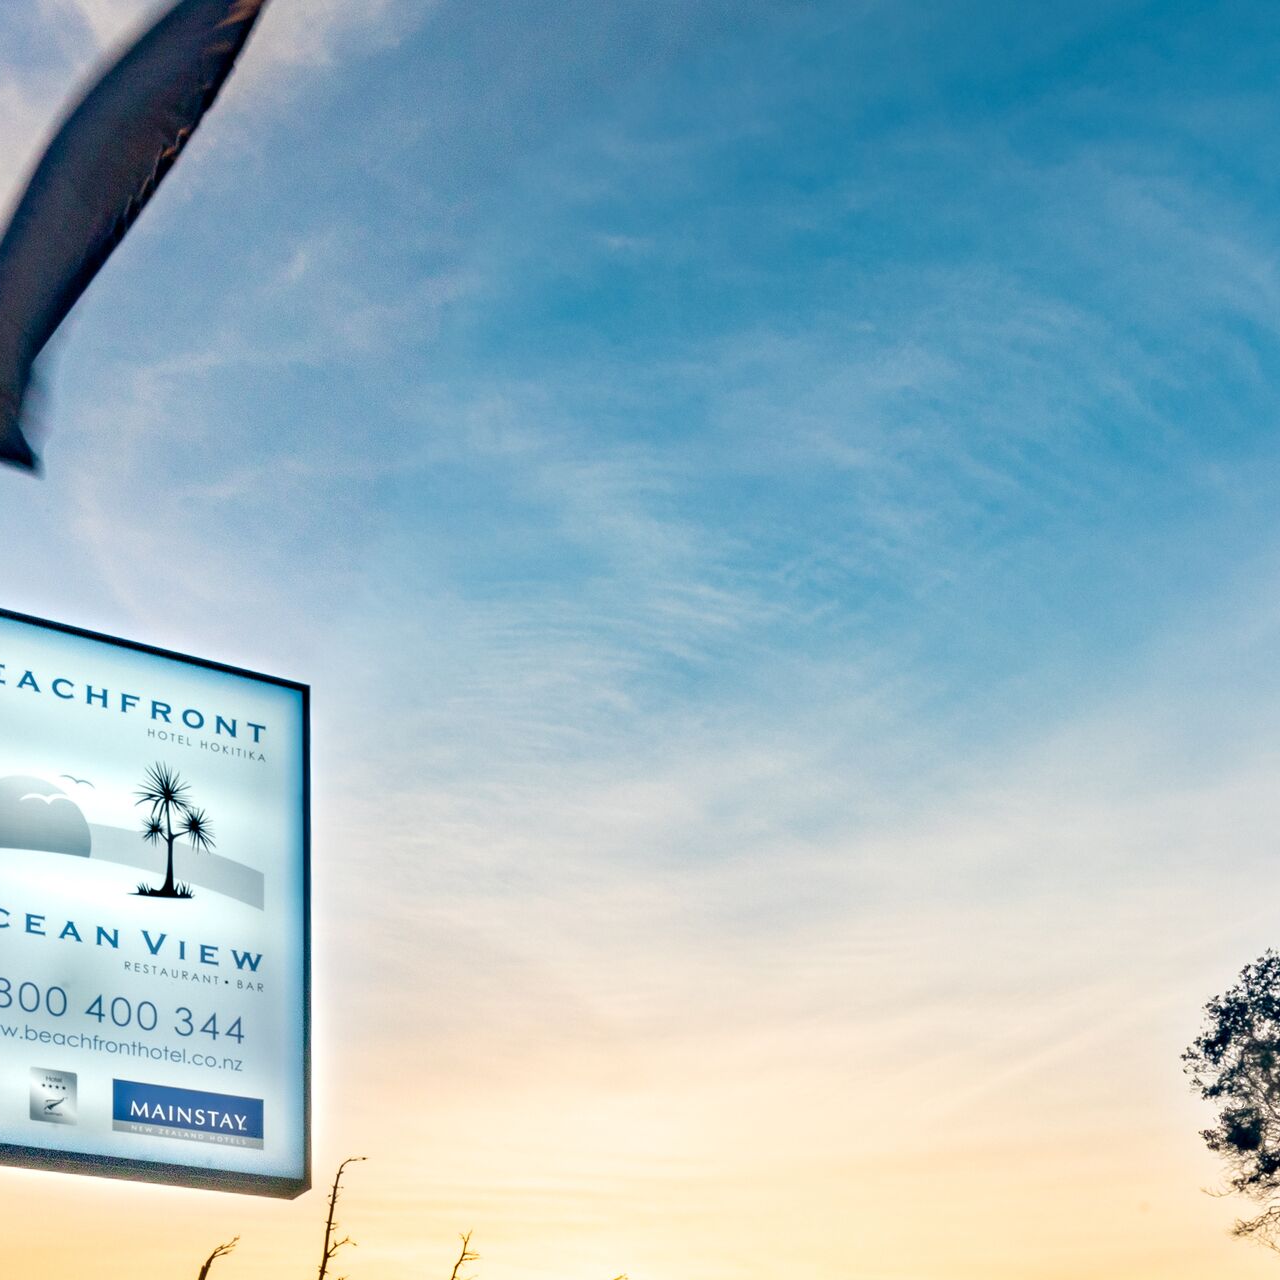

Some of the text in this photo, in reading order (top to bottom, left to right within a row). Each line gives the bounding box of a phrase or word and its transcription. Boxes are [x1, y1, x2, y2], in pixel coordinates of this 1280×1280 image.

[147, 728, 266, 762] HOTEL HOKITIKA
[141, 929, 263, 972] VIEW
[124, 961, 264, 993] RESTAURANT BAR
[85, 994, 158, 1031] 400
[174, 1007, 245, 1044] 344
[130, 1100, 247, 1131] MAINSTAY
[131, 1125, 247, 1146] NEW ZEALAND HOTELS
